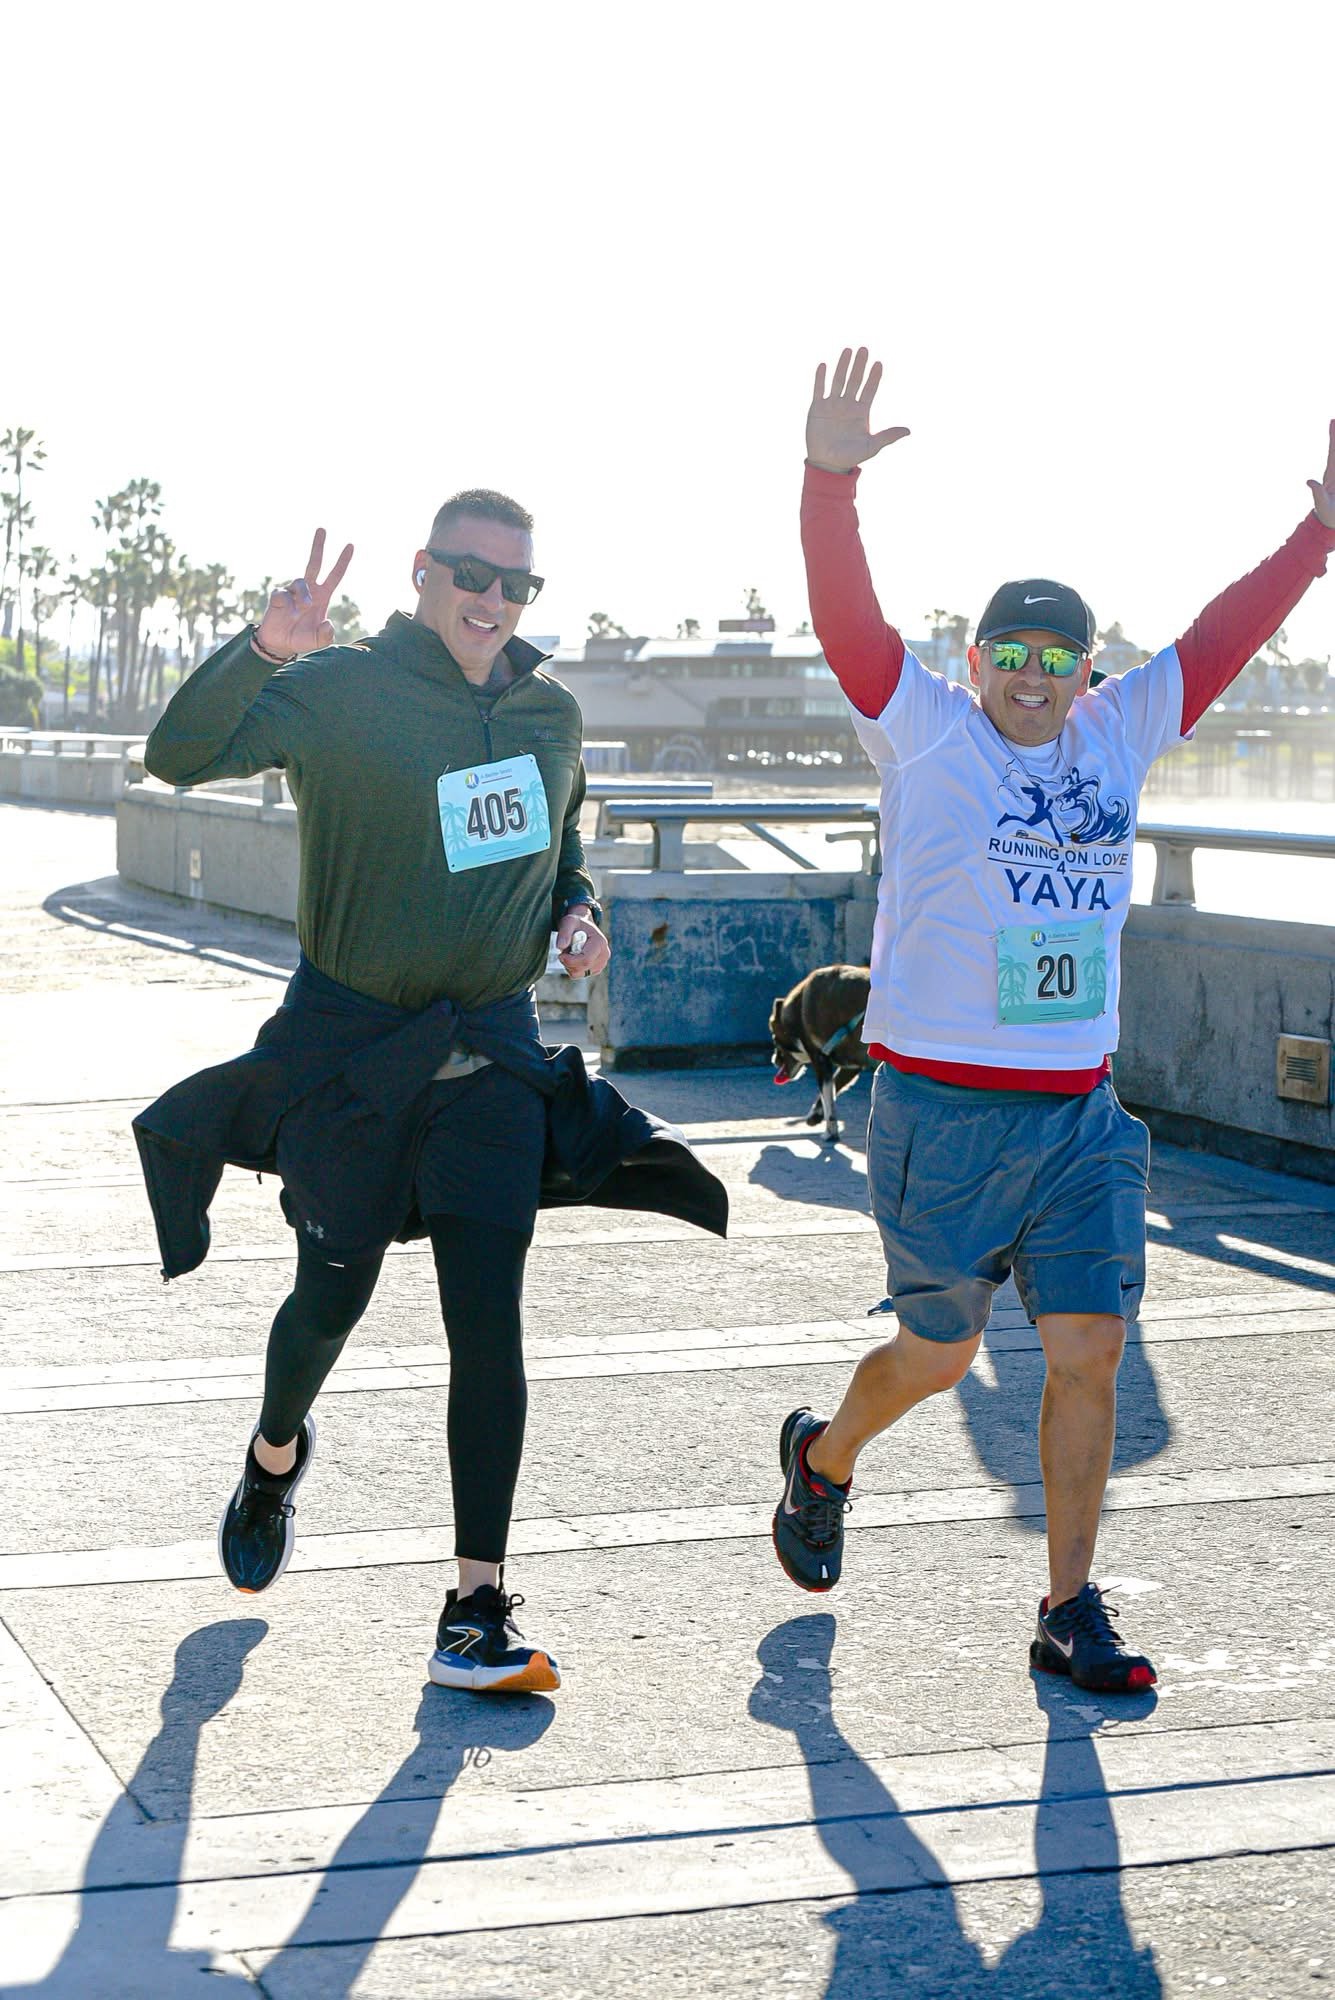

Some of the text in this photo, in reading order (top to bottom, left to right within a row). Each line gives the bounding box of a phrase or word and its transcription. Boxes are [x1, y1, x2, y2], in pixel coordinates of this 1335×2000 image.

[467, 788, 527, 840] 405
[989, 837, 1129, 866] RUNNING ON LOVE
[1056, 861, 1067, 875] 4
[1005, 868, 1111, 910] YAYA
[1037, 953, 1077, 1000] 20
